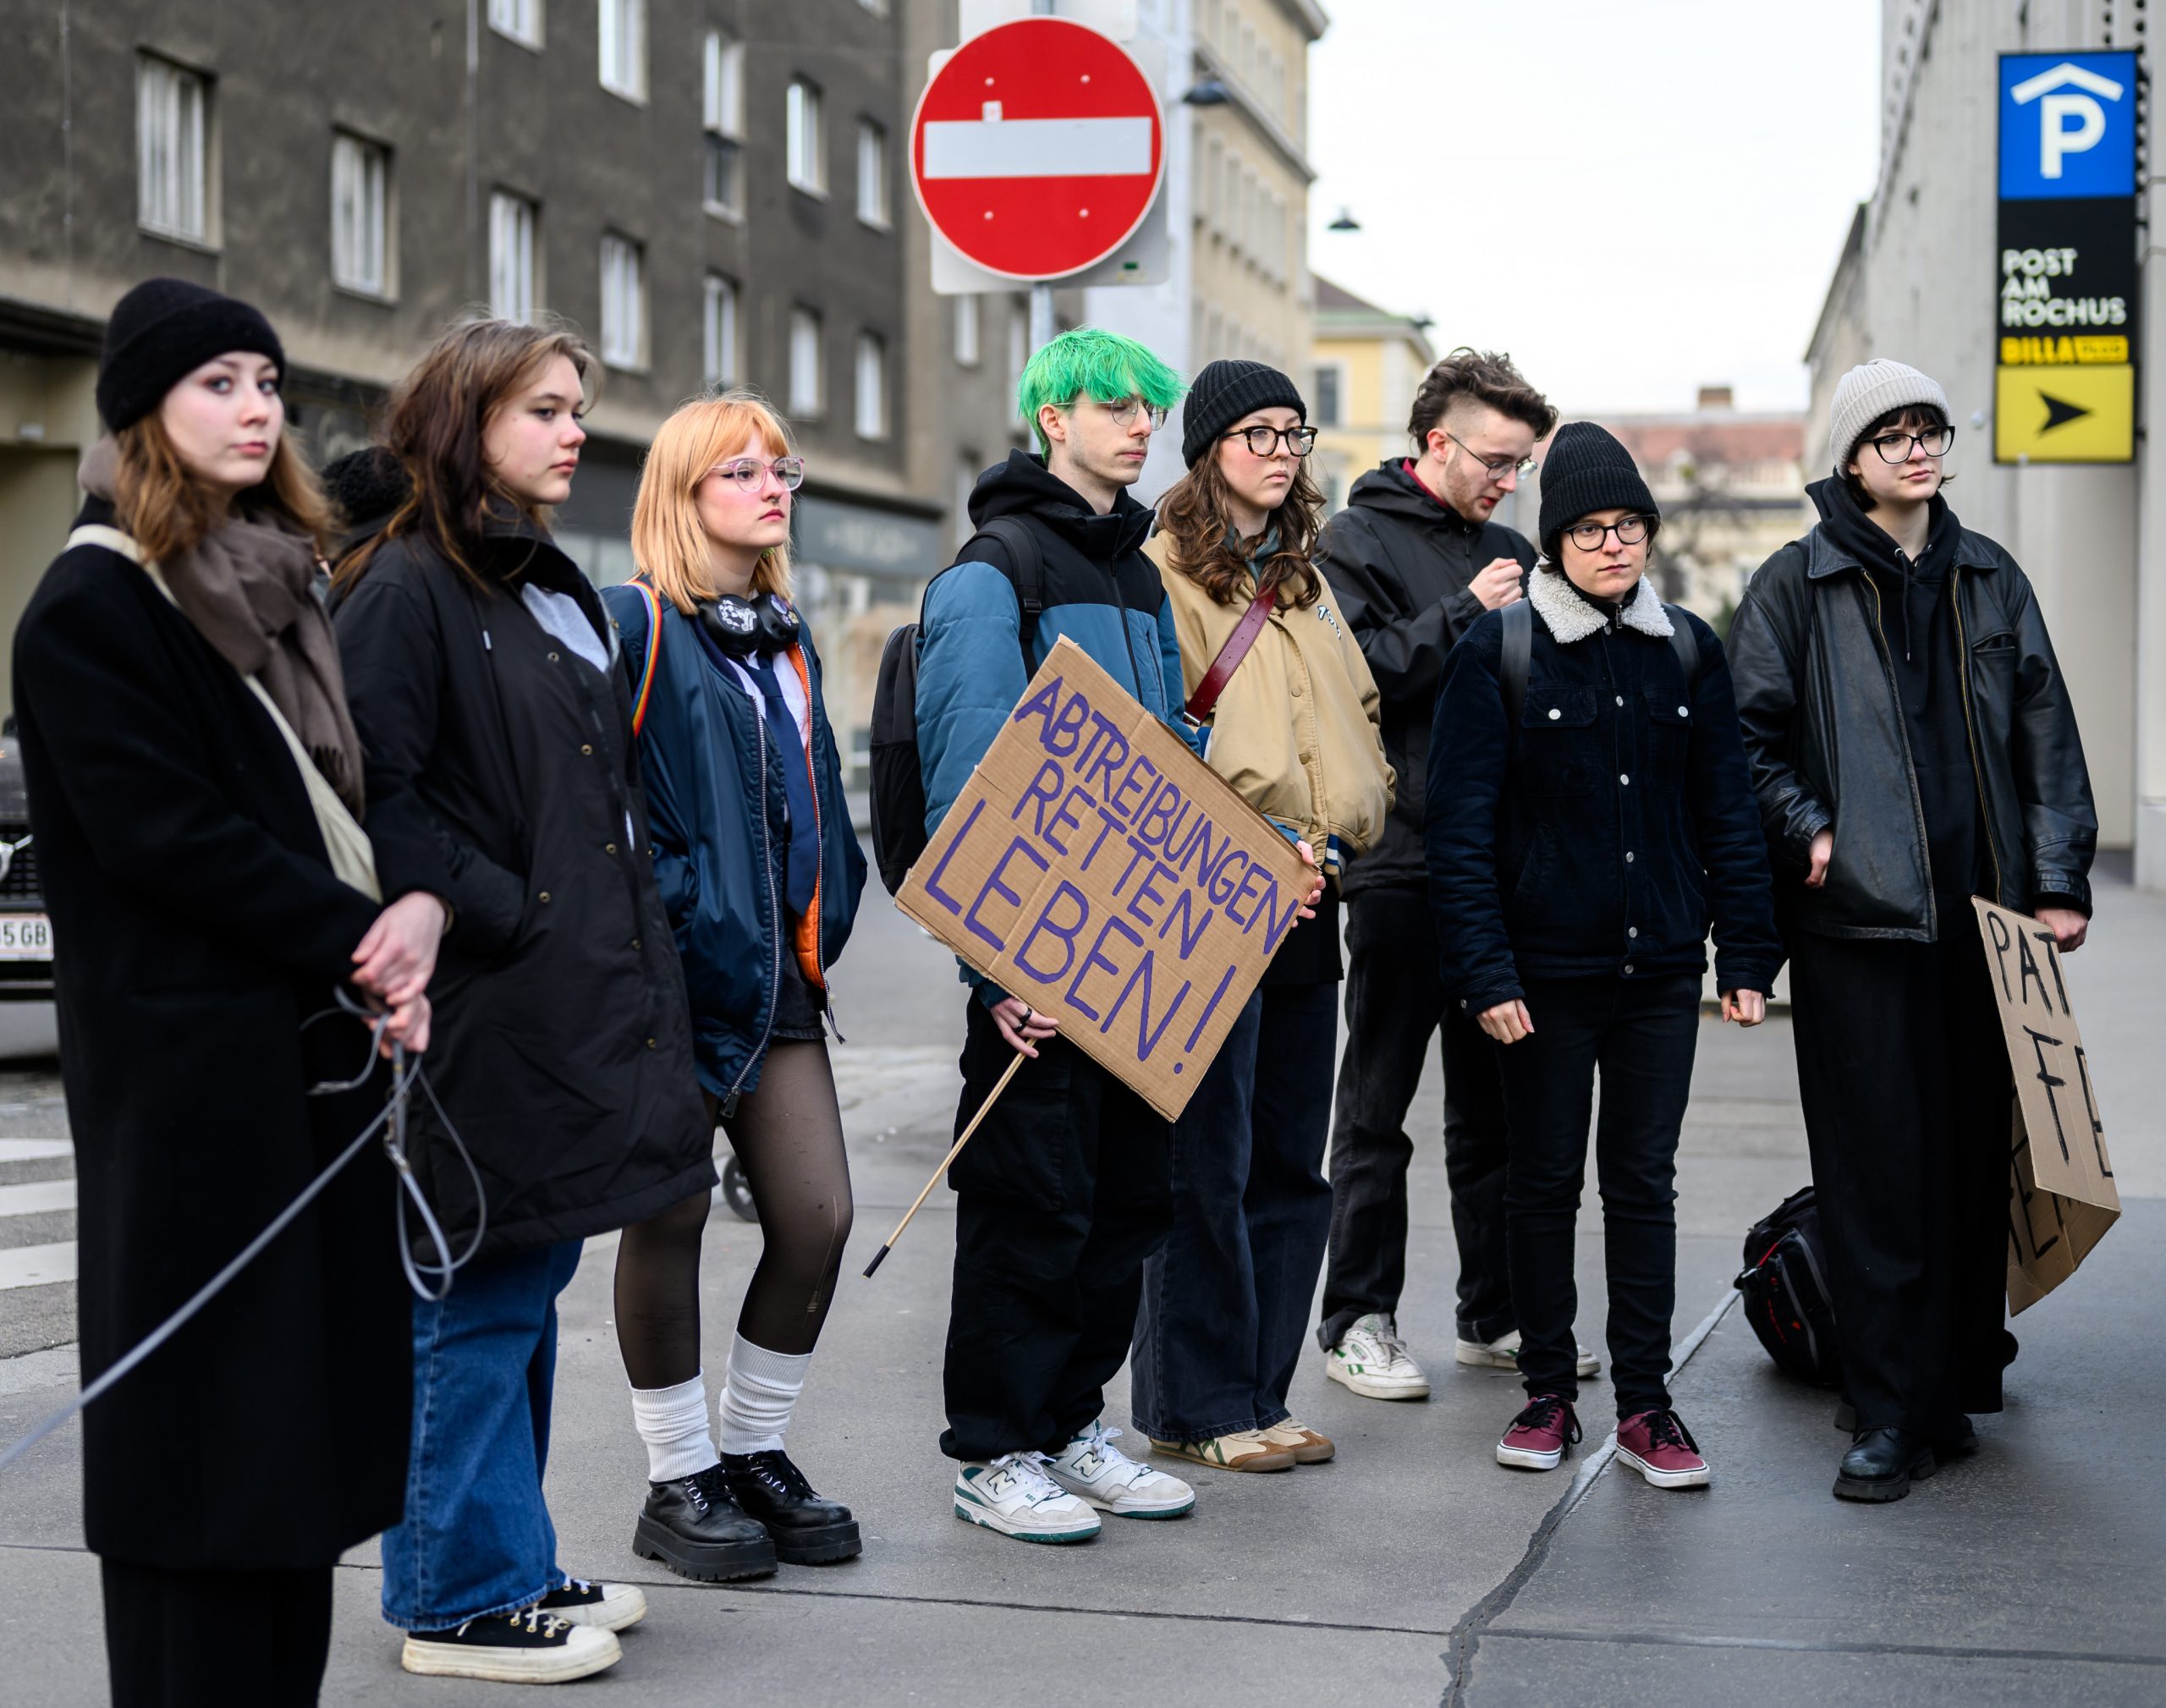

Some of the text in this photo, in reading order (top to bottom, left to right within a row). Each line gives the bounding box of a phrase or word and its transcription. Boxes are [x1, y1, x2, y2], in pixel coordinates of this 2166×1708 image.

[2040, 94, 2106, 178] P
[2002, 248, 2078, 277] POST
[2001, 274, 2050, 301] AM
[2002, 297, 2126, 327] ROCHUS
[1014, 676, 1299, 955] ABTREIBUNGEN
[1012, 759, 1213, 960] RETTEN
[20, 920, 47, 947] GB
